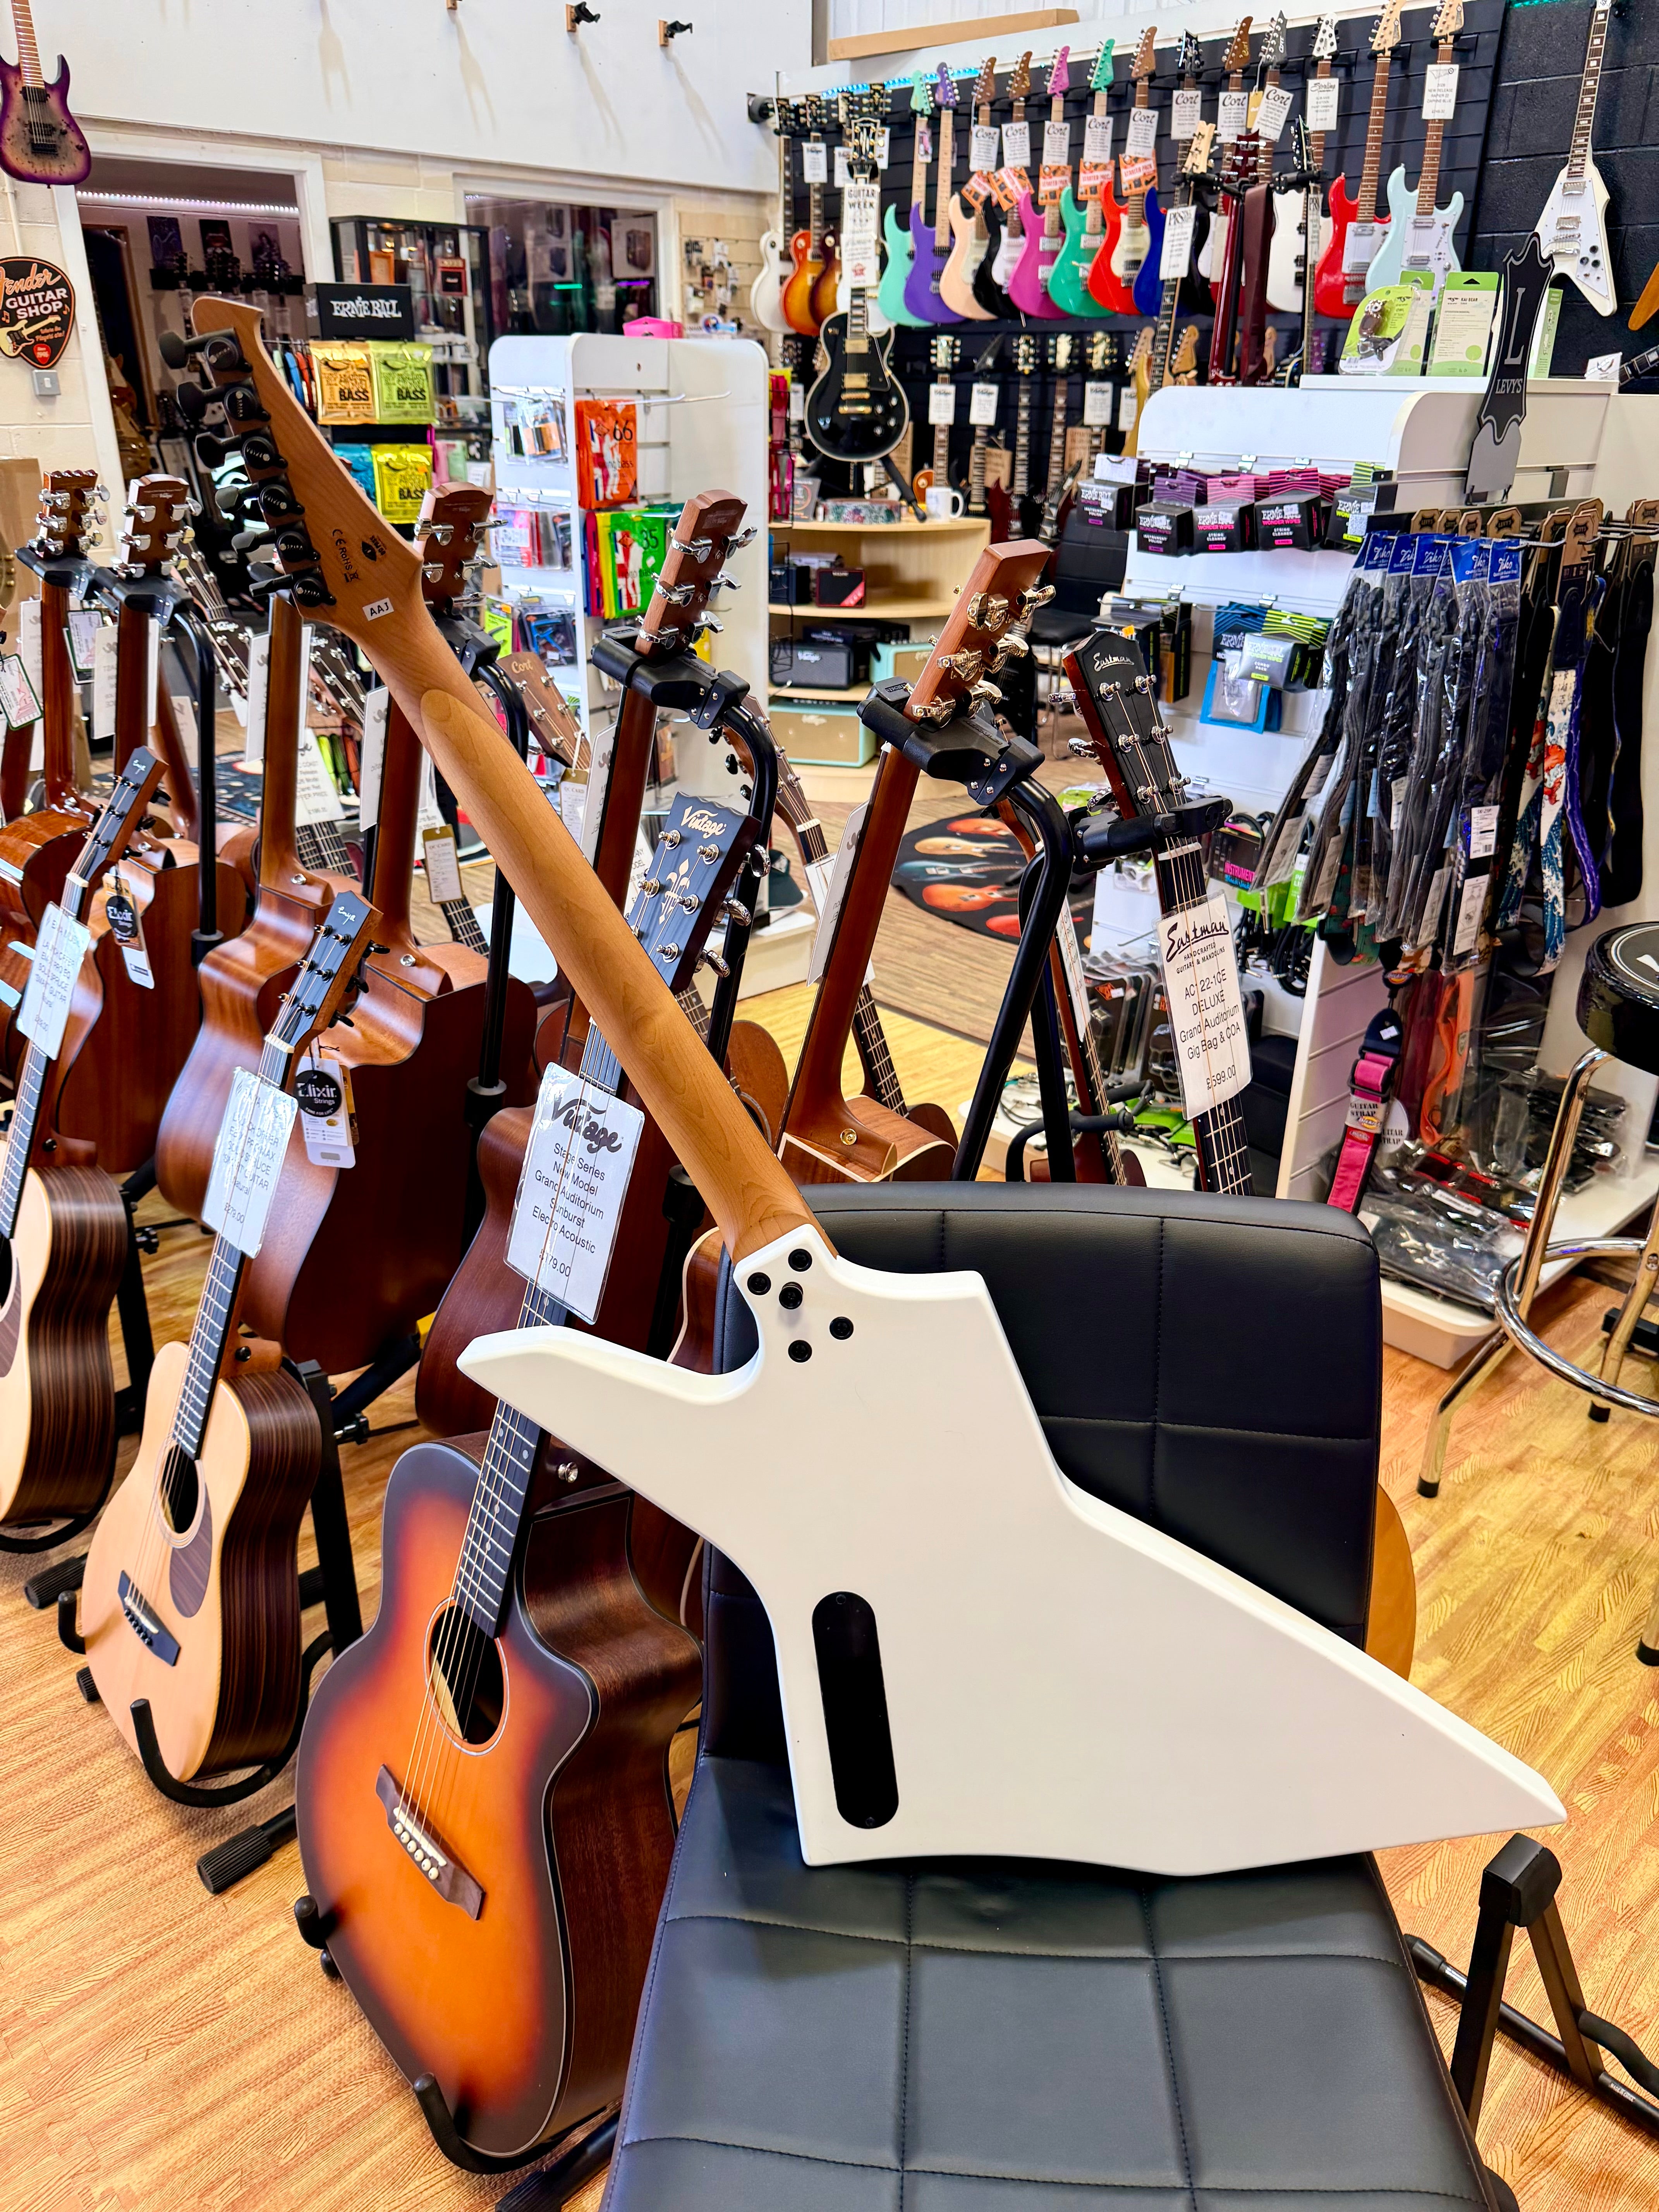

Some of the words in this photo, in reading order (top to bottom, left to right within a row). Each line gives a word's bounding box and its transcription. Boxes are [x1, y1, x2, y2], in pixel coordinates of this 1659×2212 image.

[1175, 93, 1199, 105] Cort
[1222, 94, 1247, 106] Cort
[1266, 89, 1290, 106] Cort
[1088, 117, 1110, 129] Cort
[1132, 111, 1155, 124] Cort
[1005, 126, 1027, 137] Cort
[1047, 124, 1067, 136] Cort
[848, 201, 874, 209] WEEK
[5, 288, 68, 309] GUITAR
[330, 295, 371, 318] ERNIE
[369, 299, 402, 318] BALL
[16, 301, 63, 319] SHOP
[339, 388, 369, 401] BASS
[397, 387, 426, 400] BASS
[1495, 378, 1523, 394] LEVY'S
[613, 420, 633, 441] 66
[399, 488, 426, 500] BASS
[1261, 506, 1283, 520] ERNIE
[1336, 510, 1350, 519] WON
[1338, 500, 1361, 514] ERNIE
[1197, 512, 1218, 525] ERNIE
[640, 529, 658, 550] 35
[339, 546, 353, 570] RoHS
[1400, 547, 1414, 563] Tik
[1423, 549, 1442, 565] Tiko
[1498, 555, 1513, 572] Tiko
[511, 659, 533, 674] Cort
[1093, 652, 1135, 672] Eastman
[680, 805, 726, 839] Vintage
[1224, 861, 1255, 883] INSTRUMENT
[338, 905, 356, 925] Enya
[1166, 921, 1229, 963] Eastman
[1176, 960, 1194, 974] GUITARS
[1201, 946, 1225, 963] MANDOLINS
[1183, 942, 1216, 961] HANDCRAFTED
[1185, 969, 1227, 1000] AC22-1CE
[1192, 989, 1225, 1016] DELUXE
[1179, 1018, 1202, 1043] Grand
[1203, 1003, 1240, 1030] Auditorium
[1187, 1042, 1200, 1061] Gig
[1201, 1033, 1218, 1053] Bag
[1219, 1031, 1225, 1043] &
[1226, 1024, 1242, 1039] COA
[1206, 1064, 1237, 1091] £599.00
[297, 1082, 337, 1098] Elixir
[314, 1097, 335, 1106] Strings
[551, 1098, 622, 1153] Vintage
[1381, 1128, 1403, 1137] UITAR
[553, 1142, 575, 1166] Stage
[577, 1157, 605, 1182] Series
[234, 1175, 251, 1196] atural
[553, 1161, 570, 1180] New
[571, 1172, 598, 1196] Model
[535, 1169, 558, 1192] Grand
[560, 1183, 604, 1220] Auditorium
[550, 1197, 586, 1229] Sunburst
[532, 1206, 558, 1231] Elecro
[558, 1223, 596, 1254] Acoustic
